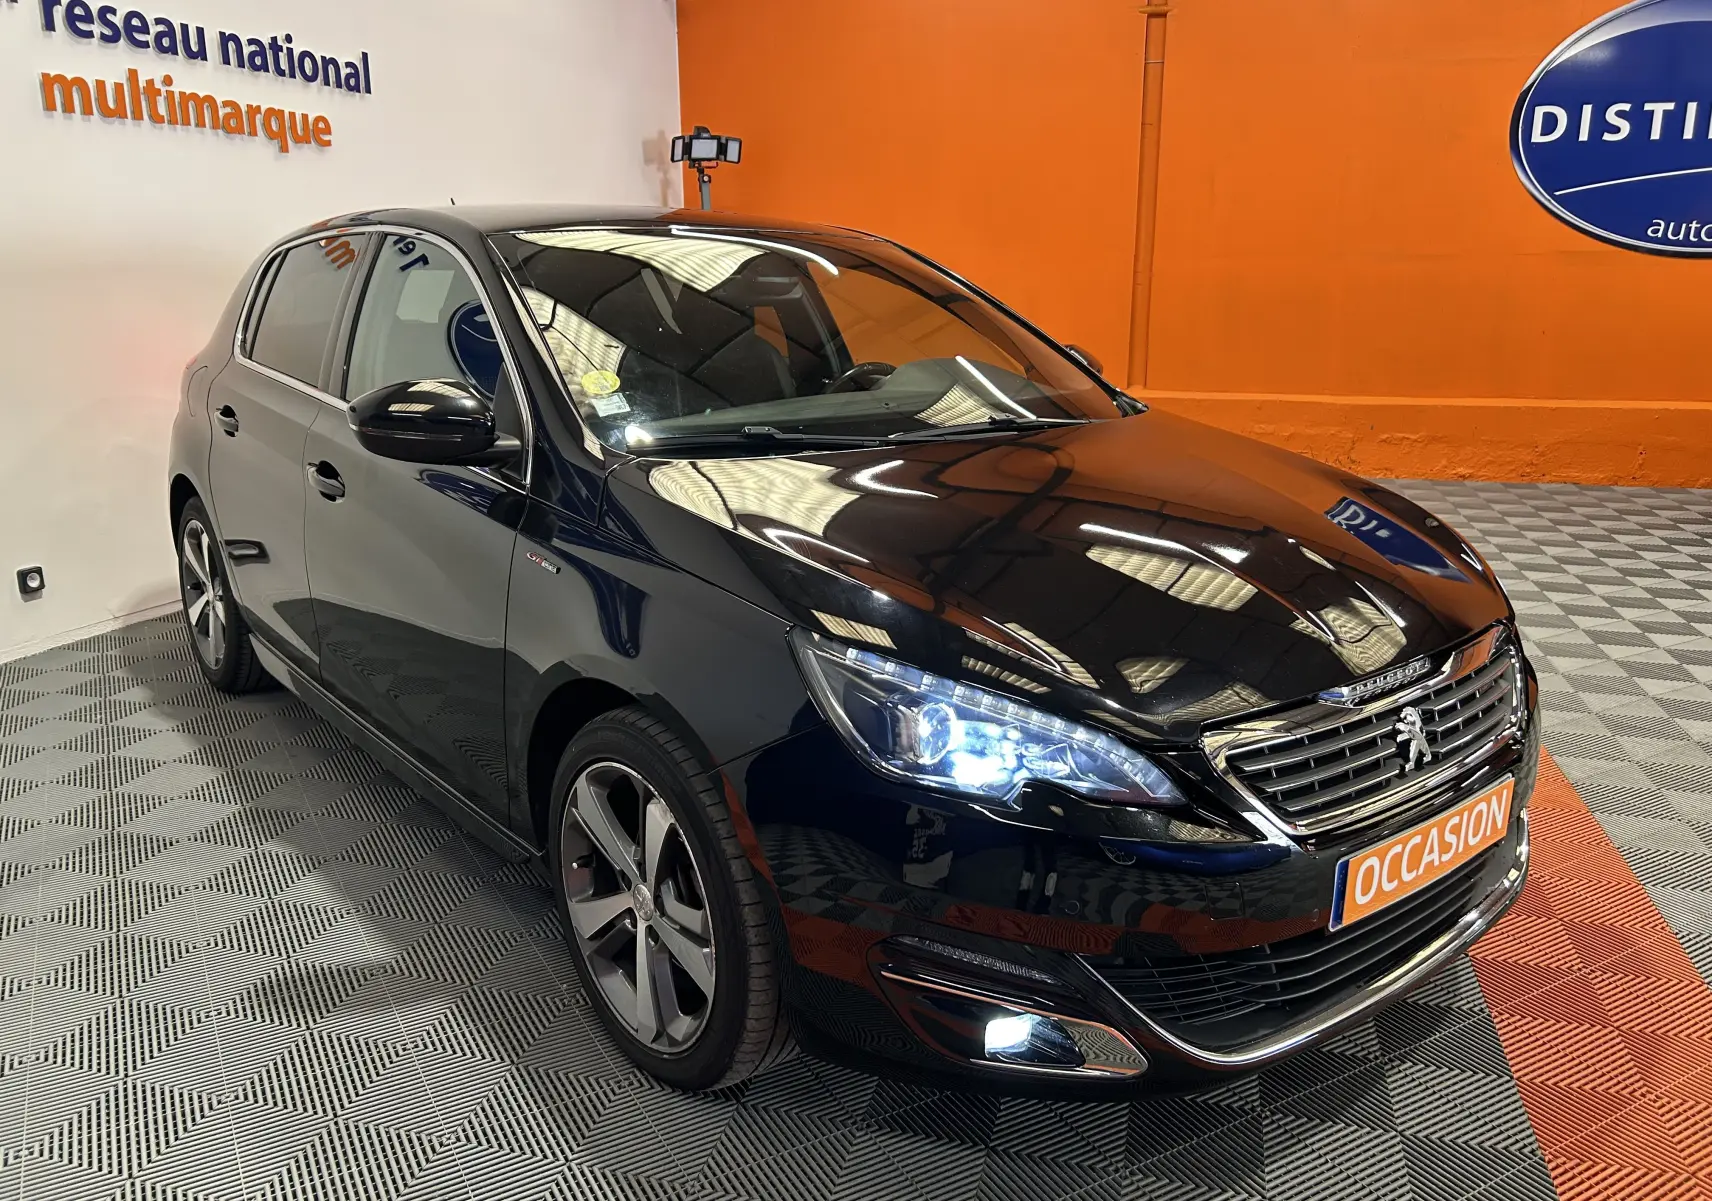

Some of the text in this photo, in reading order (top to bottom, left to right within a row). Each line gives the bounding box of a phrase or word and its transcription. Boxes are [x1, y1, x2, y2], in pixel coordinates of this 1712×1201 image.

[219, 30, 372, 94] national
[41, 68, 332, 153] multimarque
[1530, 101, 1712, 143] DISTI
[1355, 662, 1424, 693] PEUGEOT
[1354, 788, 1509, 906] OCCASION
